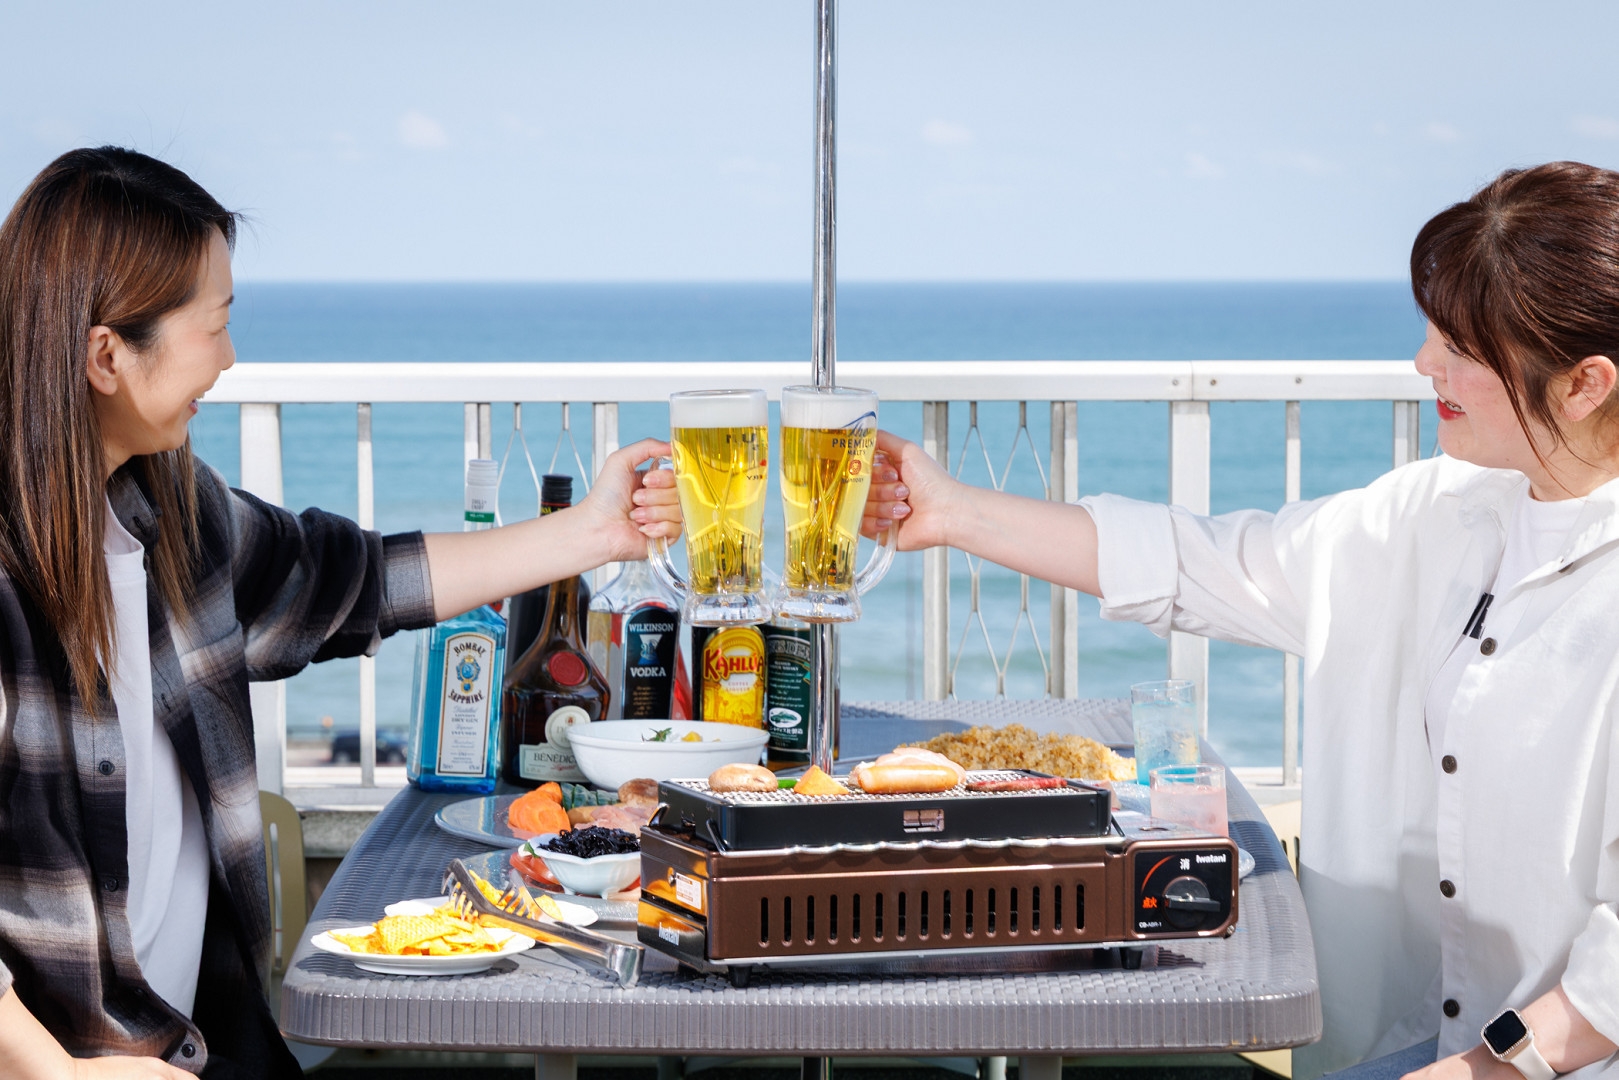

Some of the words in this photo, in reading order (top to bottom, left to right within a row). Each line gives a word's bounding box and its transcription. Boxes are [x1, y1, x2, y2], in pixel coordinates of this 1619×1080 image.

[628, 622, 674, 632] WILKINSON
[453, 642, 487, 658] BOMBAY
[704, 649, 764, 681] KAHLÚA
[630, 666, 666, 677] VODKA
[448, 689, 486, 704] SAPPHIRE
[1179, 858, 1190, 870] 消
[1196, 853, 1227, 863] Iwatani
[1142, 896, 1158, 909] 点火
